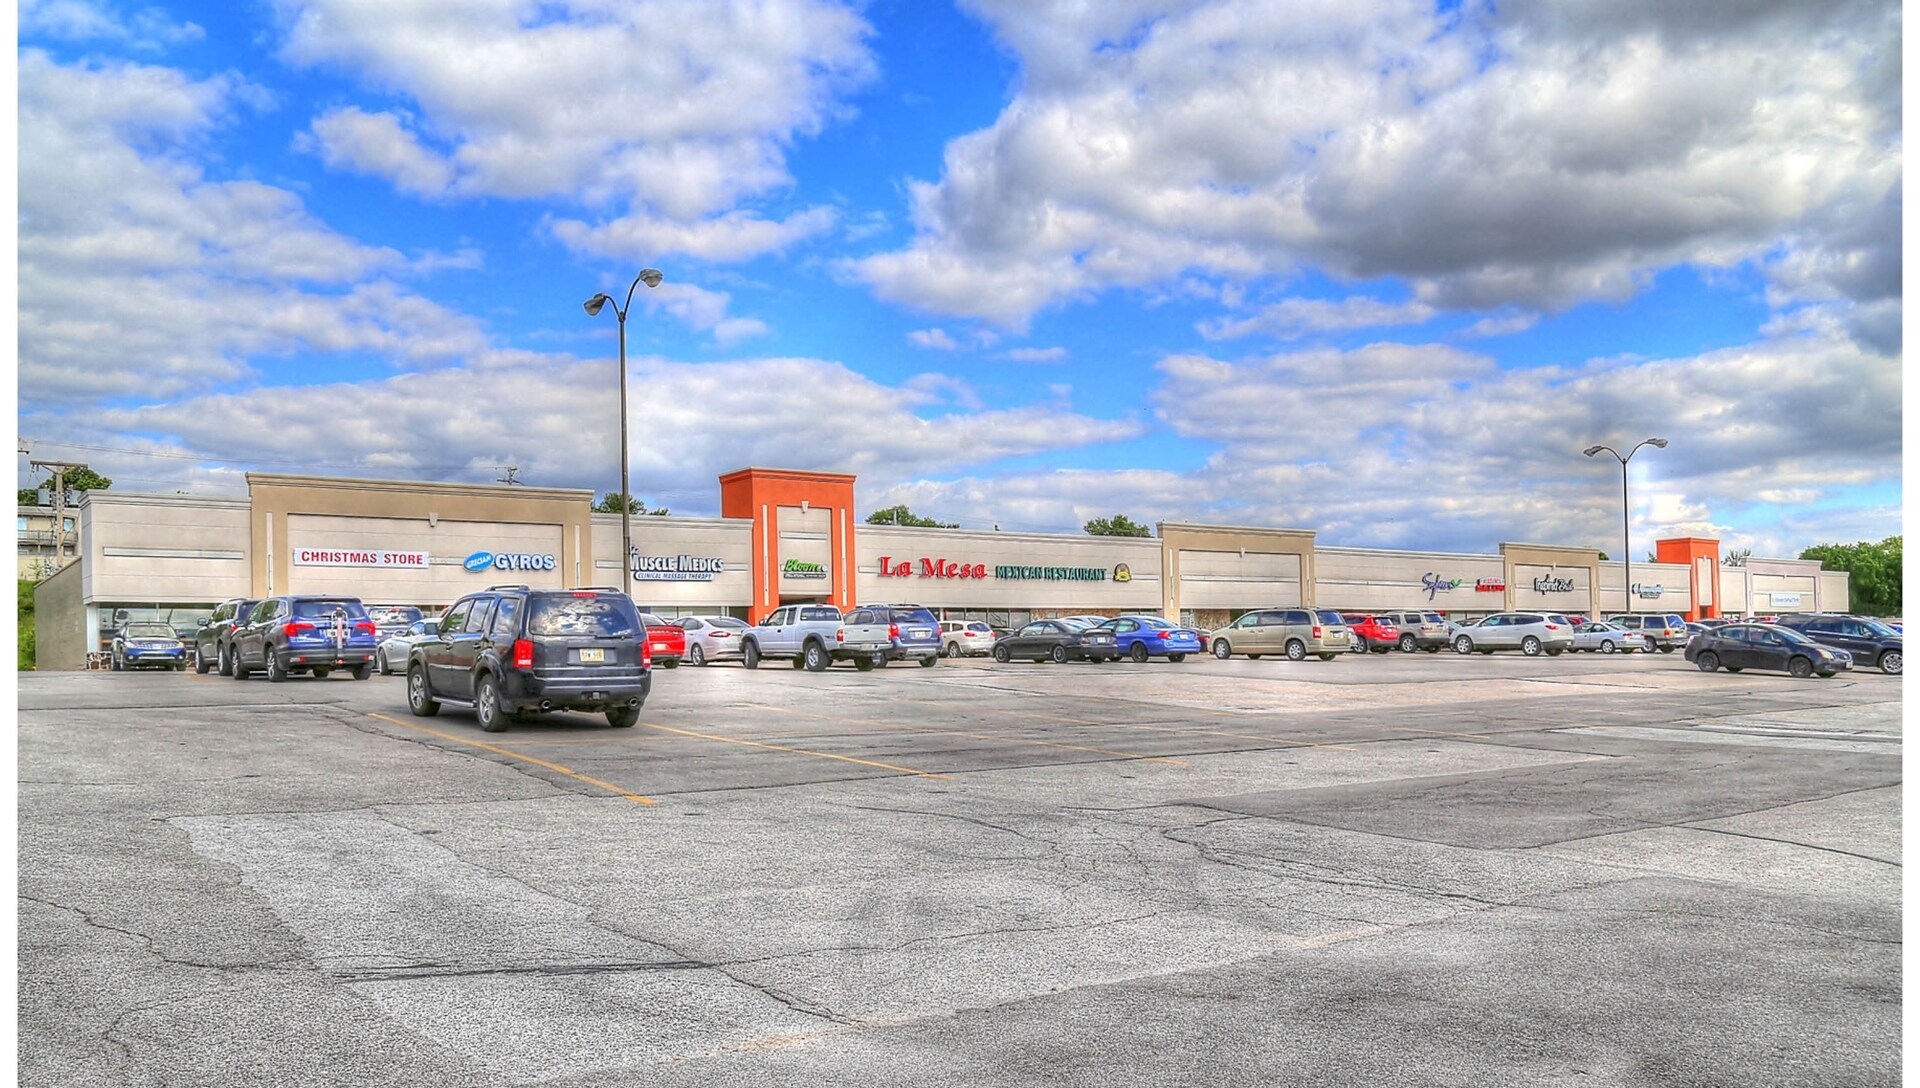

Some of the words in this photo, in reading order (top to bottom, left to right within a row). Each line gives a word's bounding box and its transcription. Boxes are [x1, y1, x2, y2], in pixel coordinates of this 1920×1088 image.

[301, 551, 377, 563] CHRISTMAS
[384, 553, 423, 565] STORE
[494, 553, 556, 570] GYROS
[677, 555, 724, 573] MEDICS
[878, 556, 914, 577] La
[919, 557, 988, 579] Mesa
[995, 565, 1042, 580] MEXICAN
[1043, 567, 1107, 581] RESTAURANT
